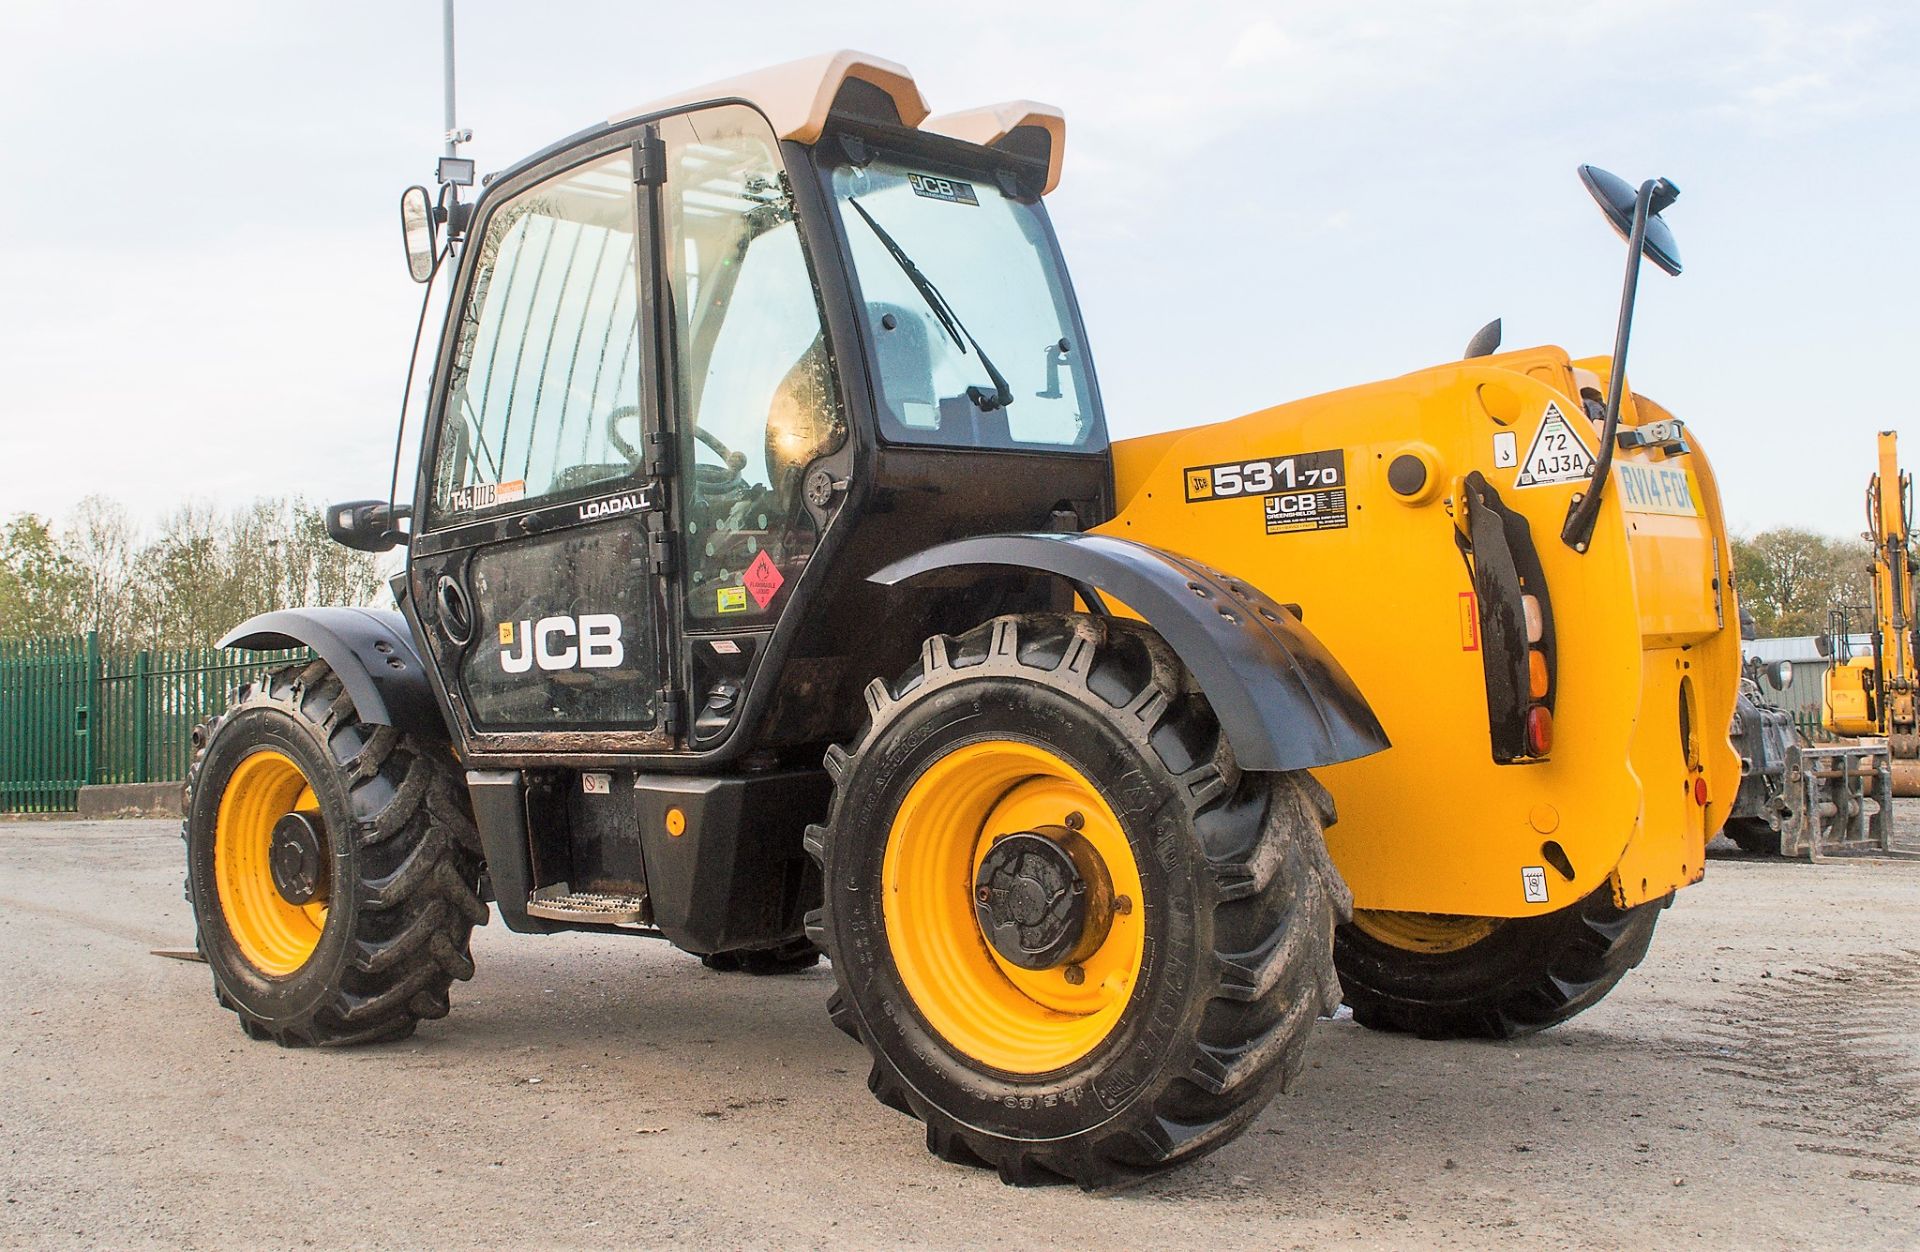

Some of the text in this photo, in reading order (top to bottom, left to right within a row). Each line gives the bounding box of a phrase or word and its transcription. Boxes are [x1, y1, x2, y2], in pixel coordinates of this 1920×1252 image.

[913, 176, 954, 196] JCB
[1545, 434, 1567, 451] 72
[1538, 454, 1583, 475] AJ3A
[1214, 458, 1338, 496] 531-70
[579, 494, 650, 520] LOADALL
[1266, 494, 1317, 514] JCB
[500, 613, 624, 674] JCB
